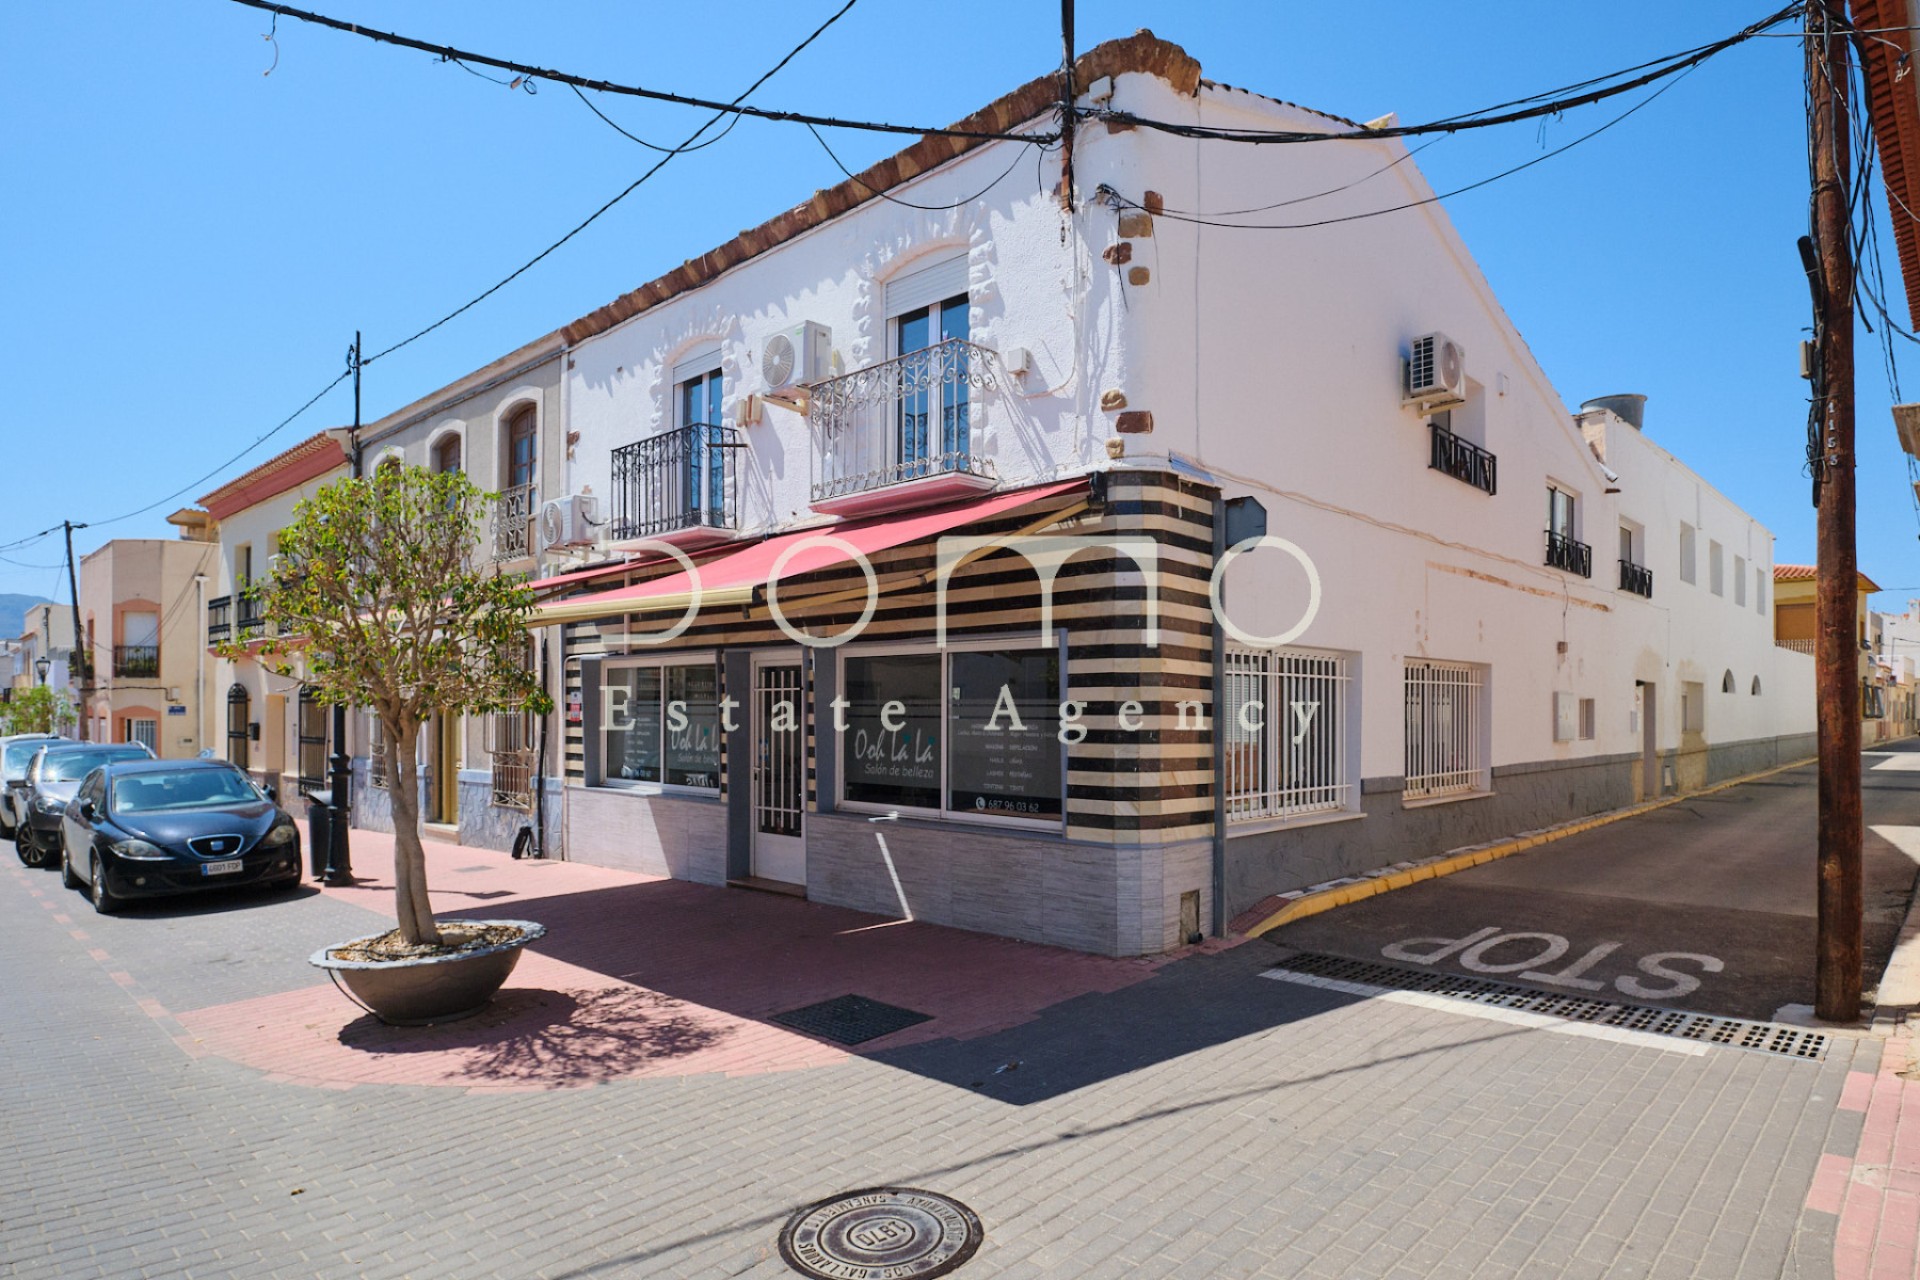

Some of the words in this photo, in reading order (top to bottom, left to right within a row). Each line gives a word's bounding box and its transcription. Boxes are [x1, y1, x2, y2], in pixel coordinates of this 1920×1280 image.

[854, 728, 886, 762] Ooh
[864, 763, 887, 775] Salón
[889, 764, 900, 776] de
[902, 765, 934, 779] belleza
[988, 799, 1003, 809] 687
[1004, 800, 1015, 811] 96
[1016, 801, 1027, 812] 03
[1028, 803, 1039, 813] 62
[1380, 926, 1725, 999] STOP
